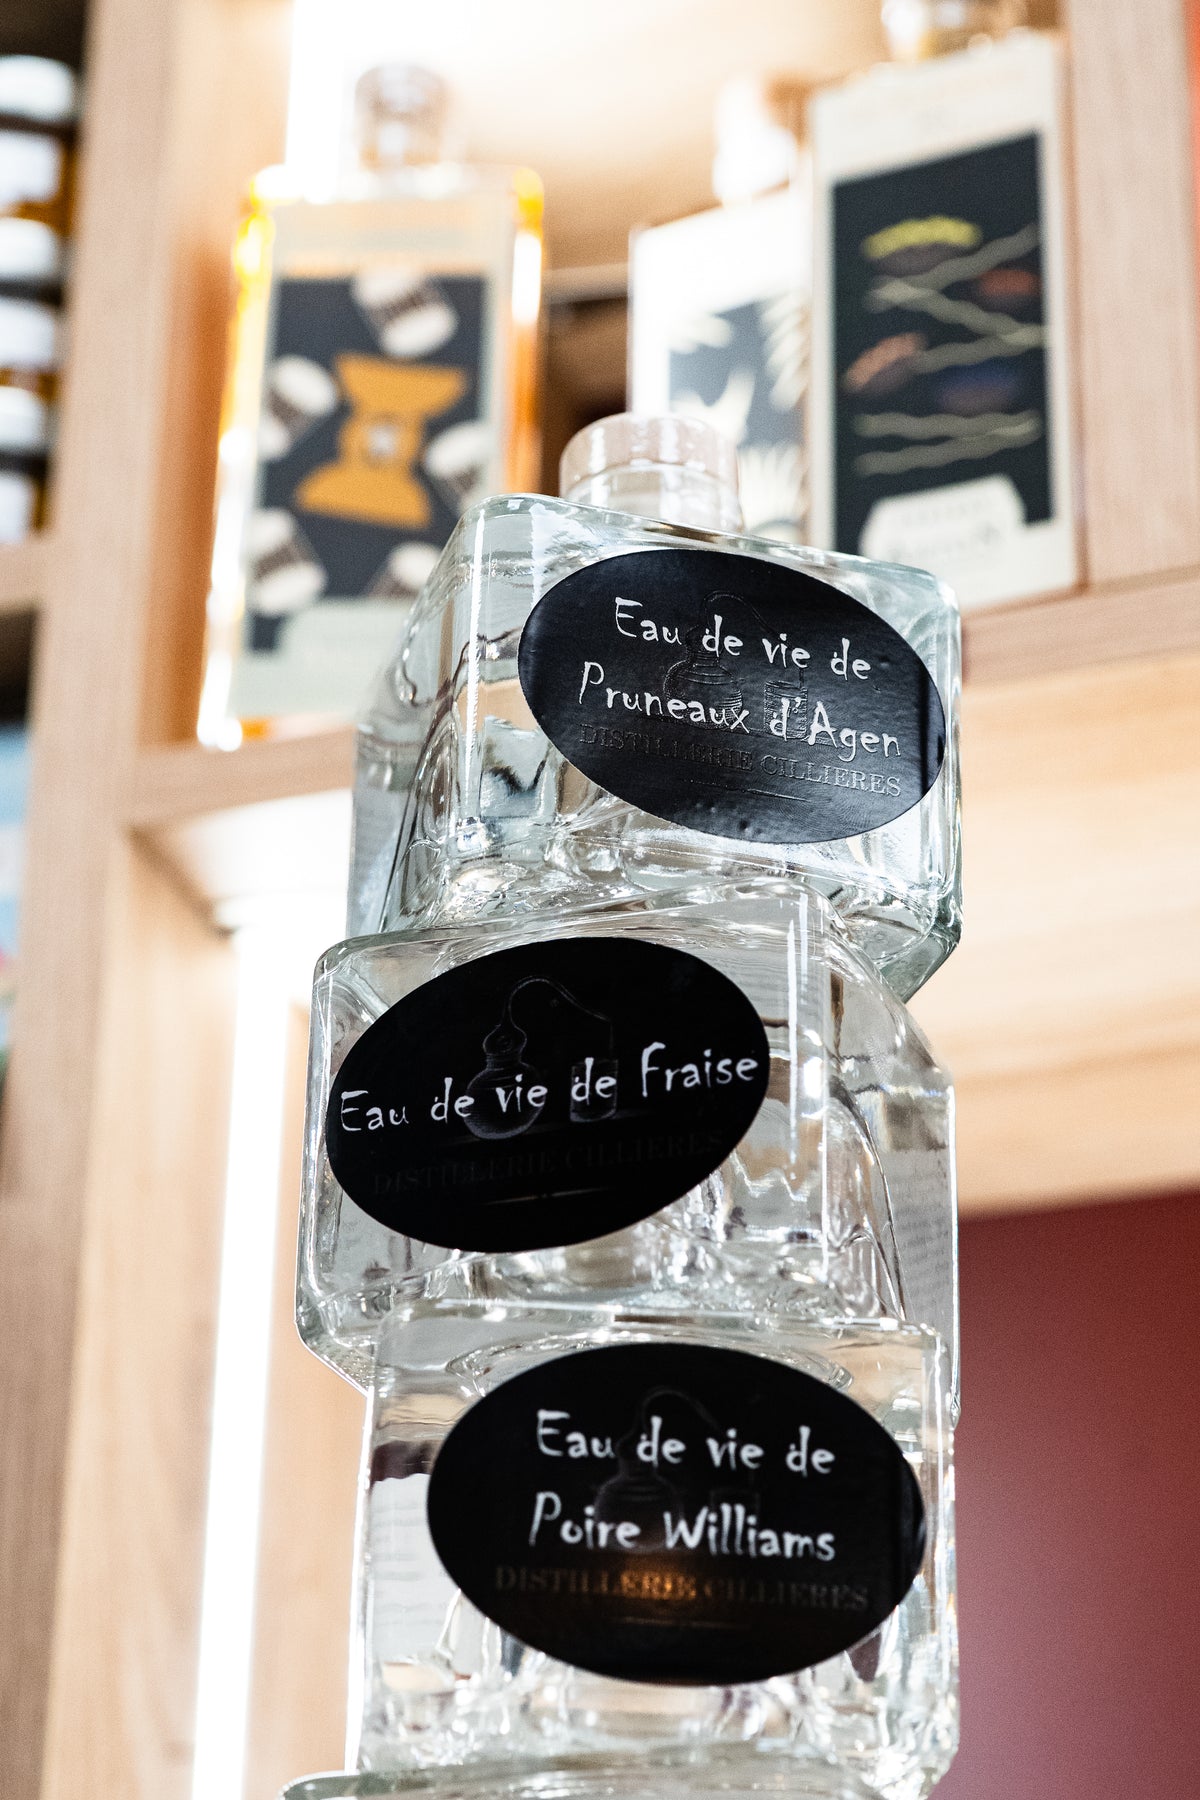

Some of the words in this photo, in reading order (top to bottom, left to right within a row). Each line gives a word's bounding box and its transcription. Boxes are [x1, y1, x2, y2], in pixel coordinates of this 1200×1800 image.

[615, 597, 680, 642] Eau
[702, 614, 743, 657] de
[762, 633, 811, 669] vie
[830, 637, 871, 681] de
[578, 661, 750, 734] Pruneaux
[769, 696, 901, 762] d'Agen
[760, 748, 901, 797] CILLIERES
[340, 1090, 409, 1132] Eau
[430, 1077, 475, 1125] de
[496, 1073, 549, 1114] vie
[570, 1056, 617, 1107] de
[640, 1041, 759, 1099] Fraise
[536, 1409, 616, 1458] Eau
[637, 1416, 687, 1468] de
[706, 1428, 765, 1471] vie
[785, 1426, 836, 1478] de
[529, 1491, 641, 1549] Poire
[663, 1502, 837, 1562] Williams
